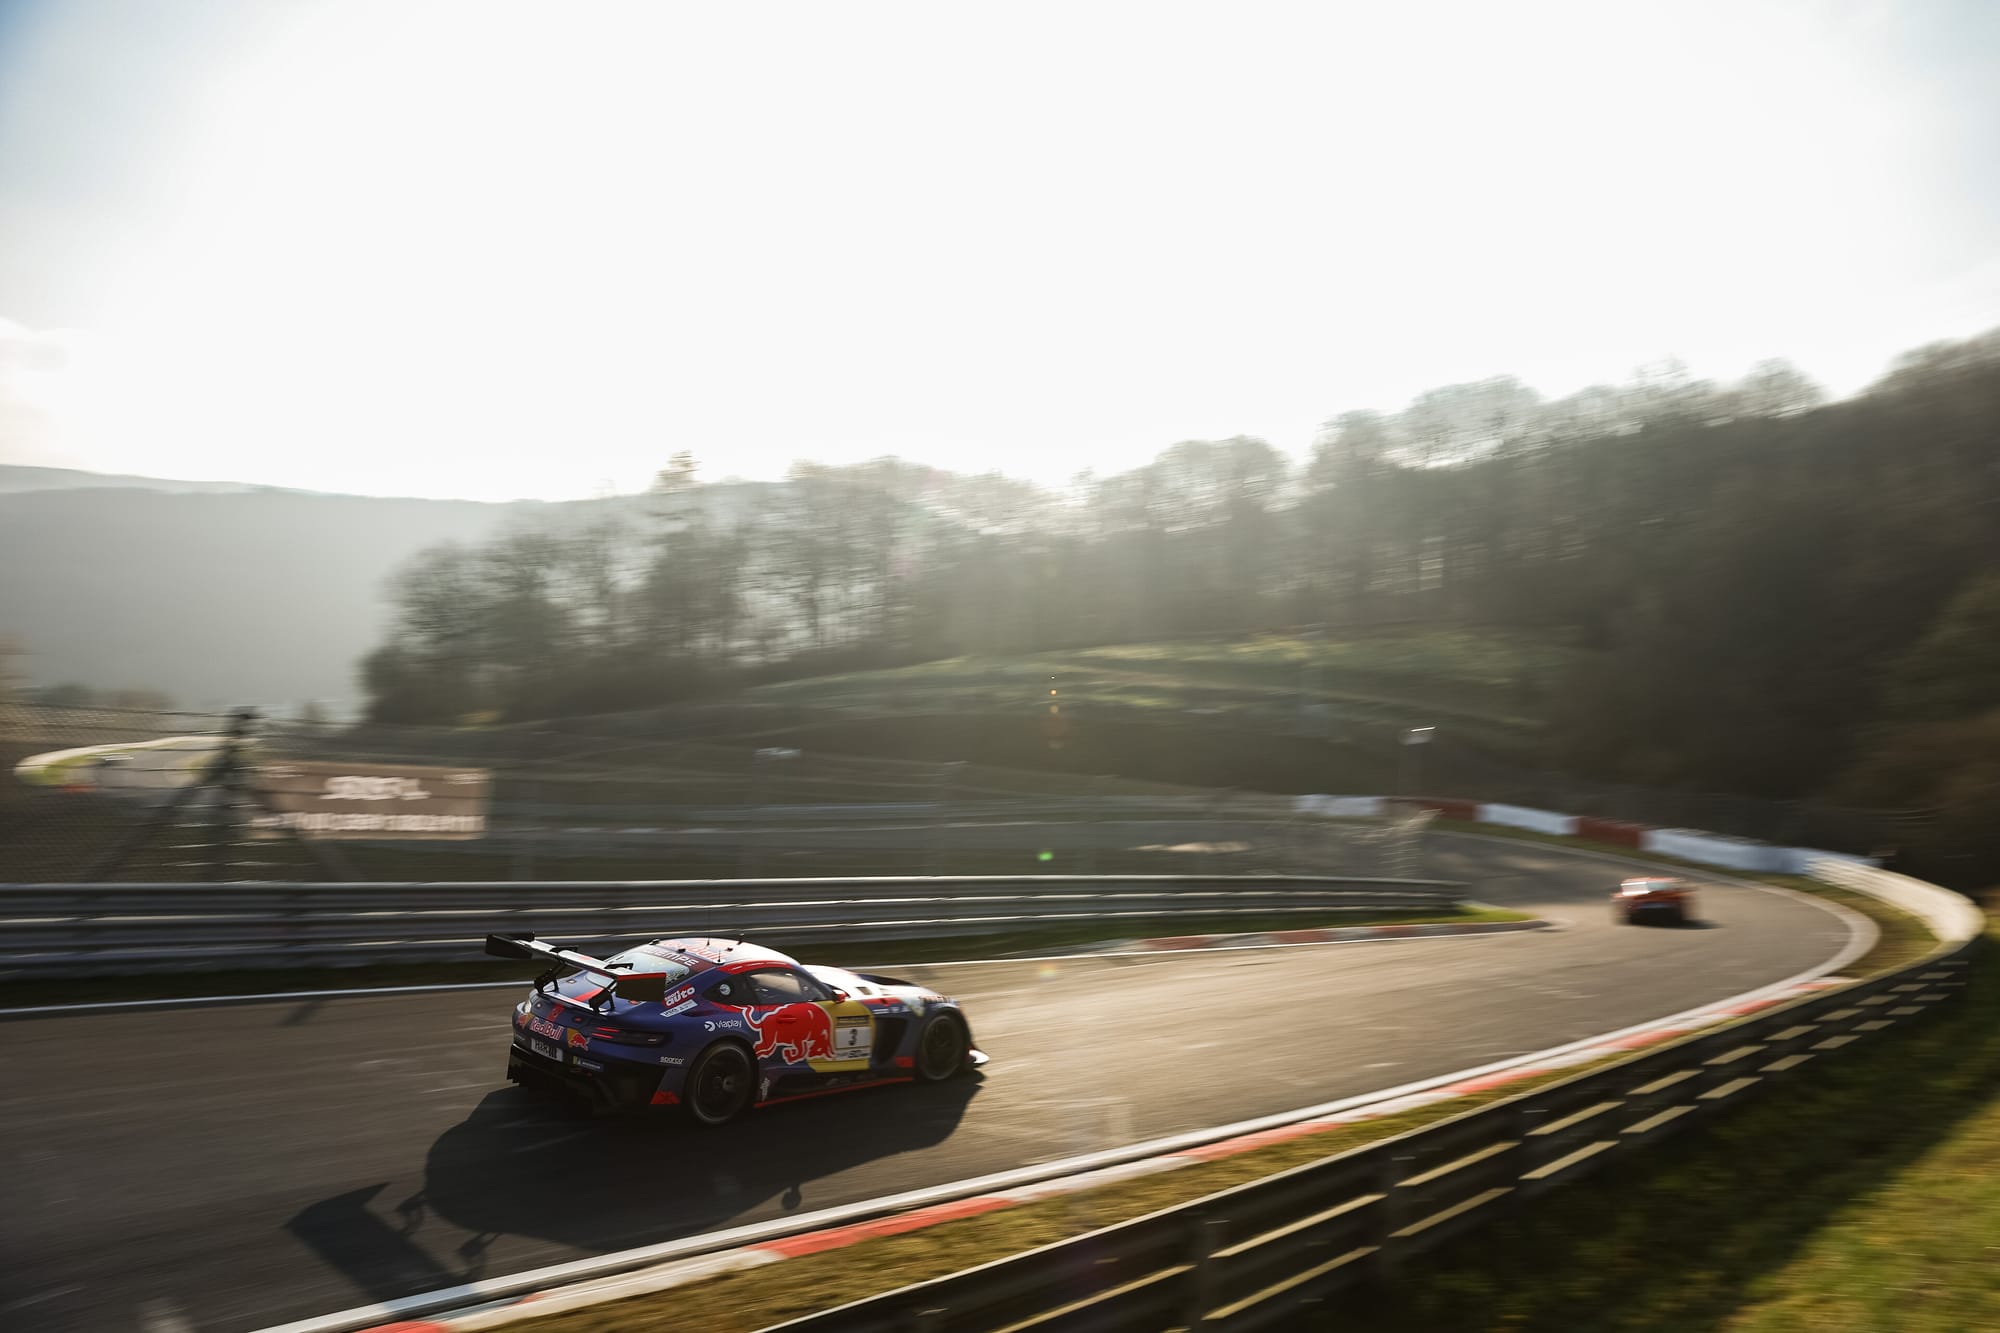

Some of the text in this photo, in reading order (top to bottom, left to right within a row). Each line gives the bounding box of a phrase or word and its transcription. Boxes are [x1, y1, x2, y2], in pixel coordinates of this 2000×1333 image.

[666, 987, 695, 1006] auto
[715, 1019, 742, 1029] viaplay
[848, 1029, 858, 1046] 3
